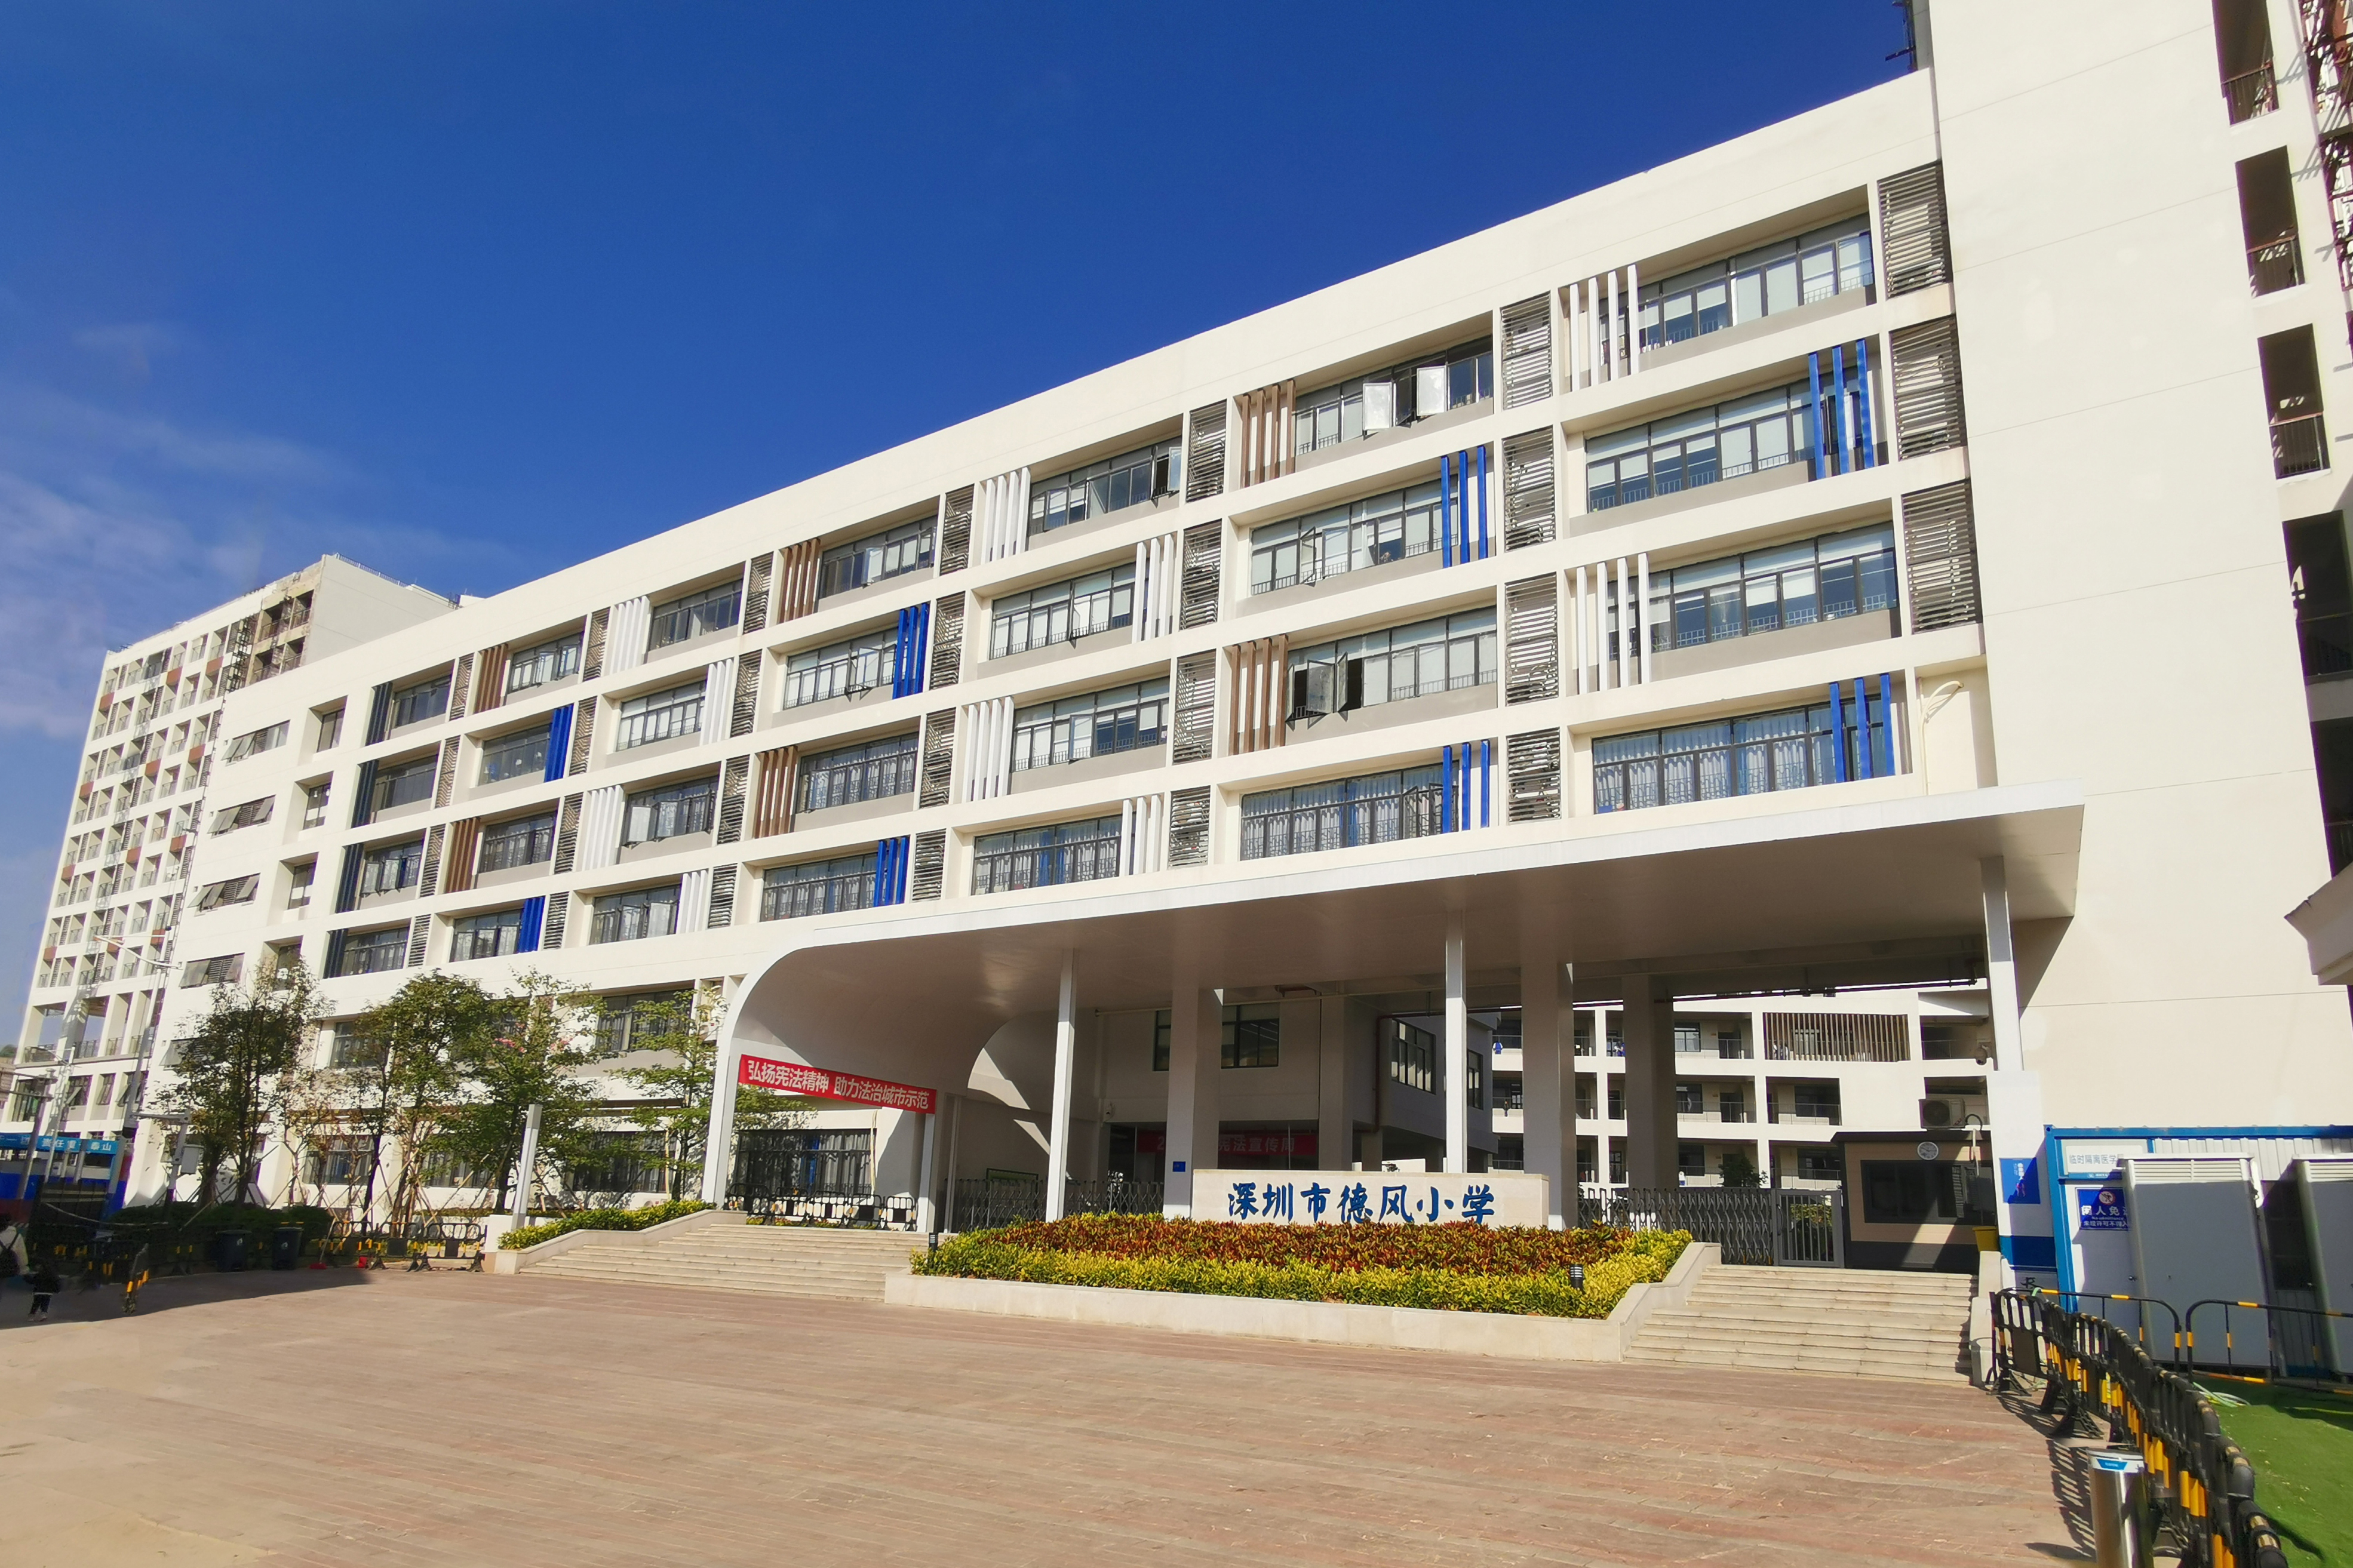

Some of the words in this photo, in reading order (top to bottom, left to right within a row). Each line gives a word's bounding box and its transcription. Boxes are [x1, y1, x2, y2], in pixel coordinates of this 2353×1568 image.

[748, 1060, 830, 1093] 弘扬宪法精神
[834, 1076, 929, 1109] 助力法治城市示范
[42, 1137, 112, 1152] 责任重泰山
[1227, 1182, 1495, 1224] 深圳市德风小学
